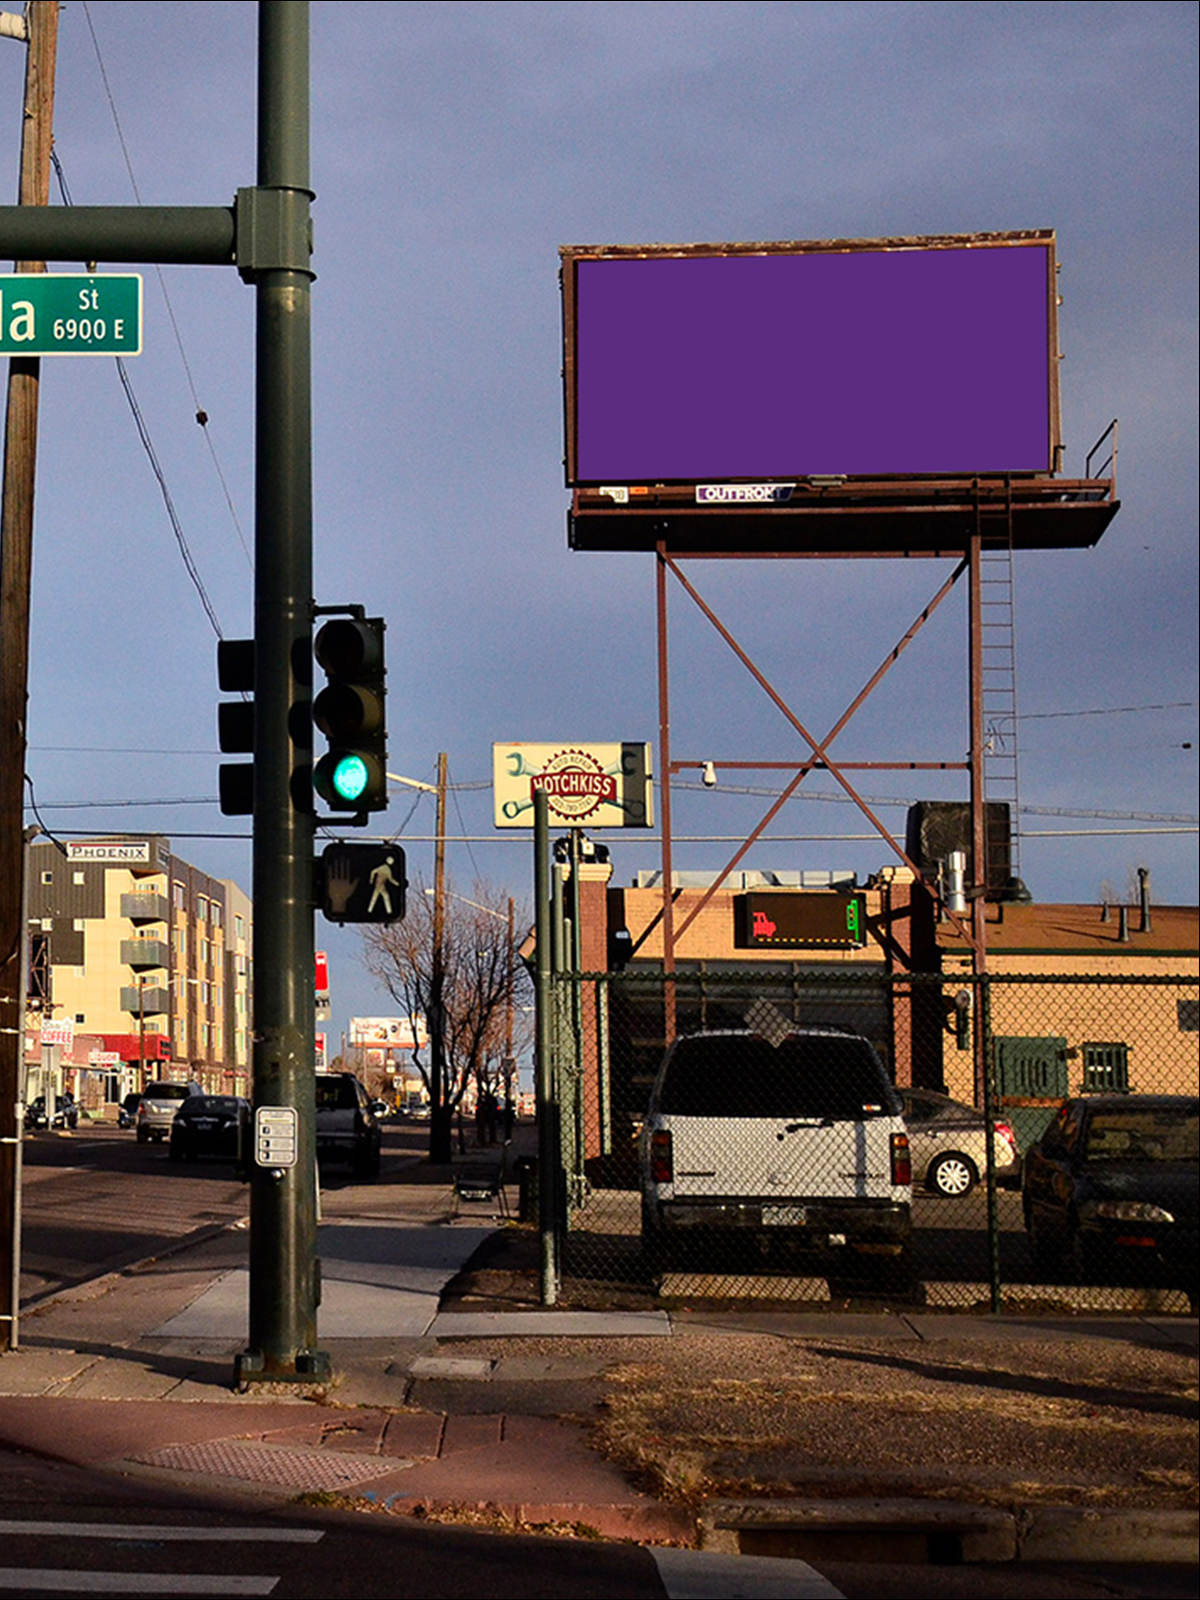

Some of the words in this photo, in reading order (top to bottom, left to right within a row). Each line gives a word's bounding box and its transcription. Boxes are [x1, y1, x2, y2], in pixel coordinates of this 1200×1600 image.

[78, 288, 99, 310] St
[53, 319, 106, 340] 6900
[114, 319, 124, 339] E
[552, 756, 568, 770] AUTO
[570, 755, 593, 770] REPAIR
[533, 774, 612, 795] HOTCHKISS
[72, 847, 146, 858] PHOENIX
[42, 1031, 72, 1043] COFFEE
[89, 1053, 118, 1062] LIQUOR
